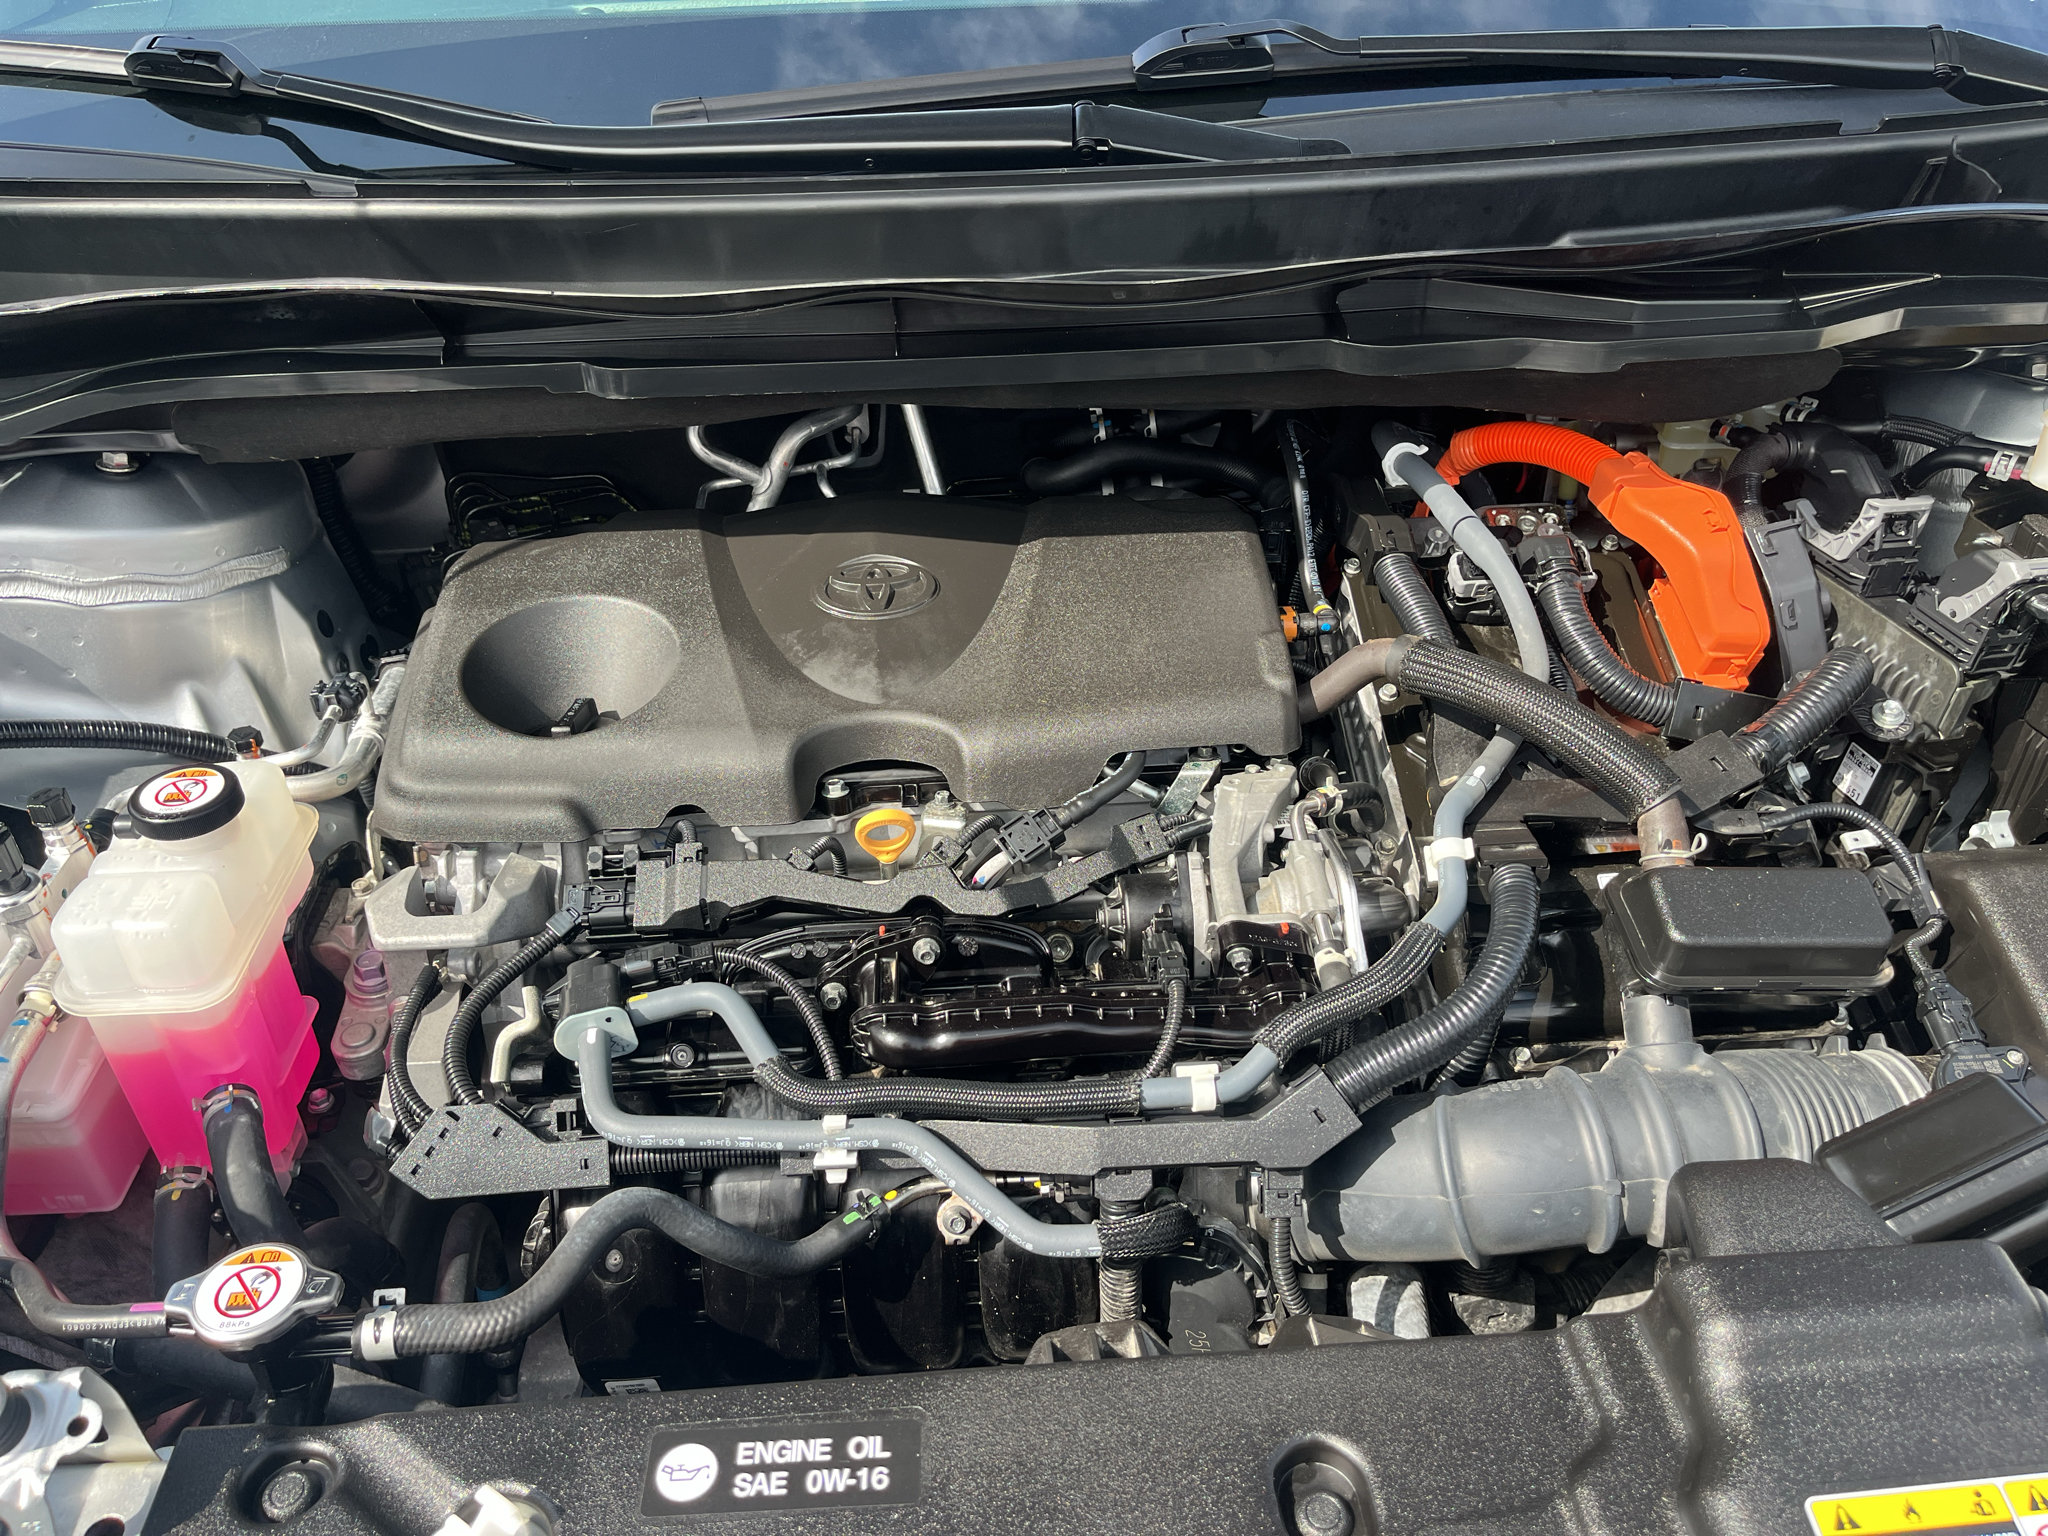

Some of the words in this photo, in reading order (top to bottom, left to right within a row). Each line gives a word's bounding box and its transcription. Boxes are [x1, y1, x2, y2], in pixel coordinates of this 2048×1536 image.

[736, 1437, 833, 1466] ENGINE
[846, 1434, 892, 1460] OIL
[731, 1471, 790, 1499] SAE
[804, 1466, 891, 1495] 0W-16
